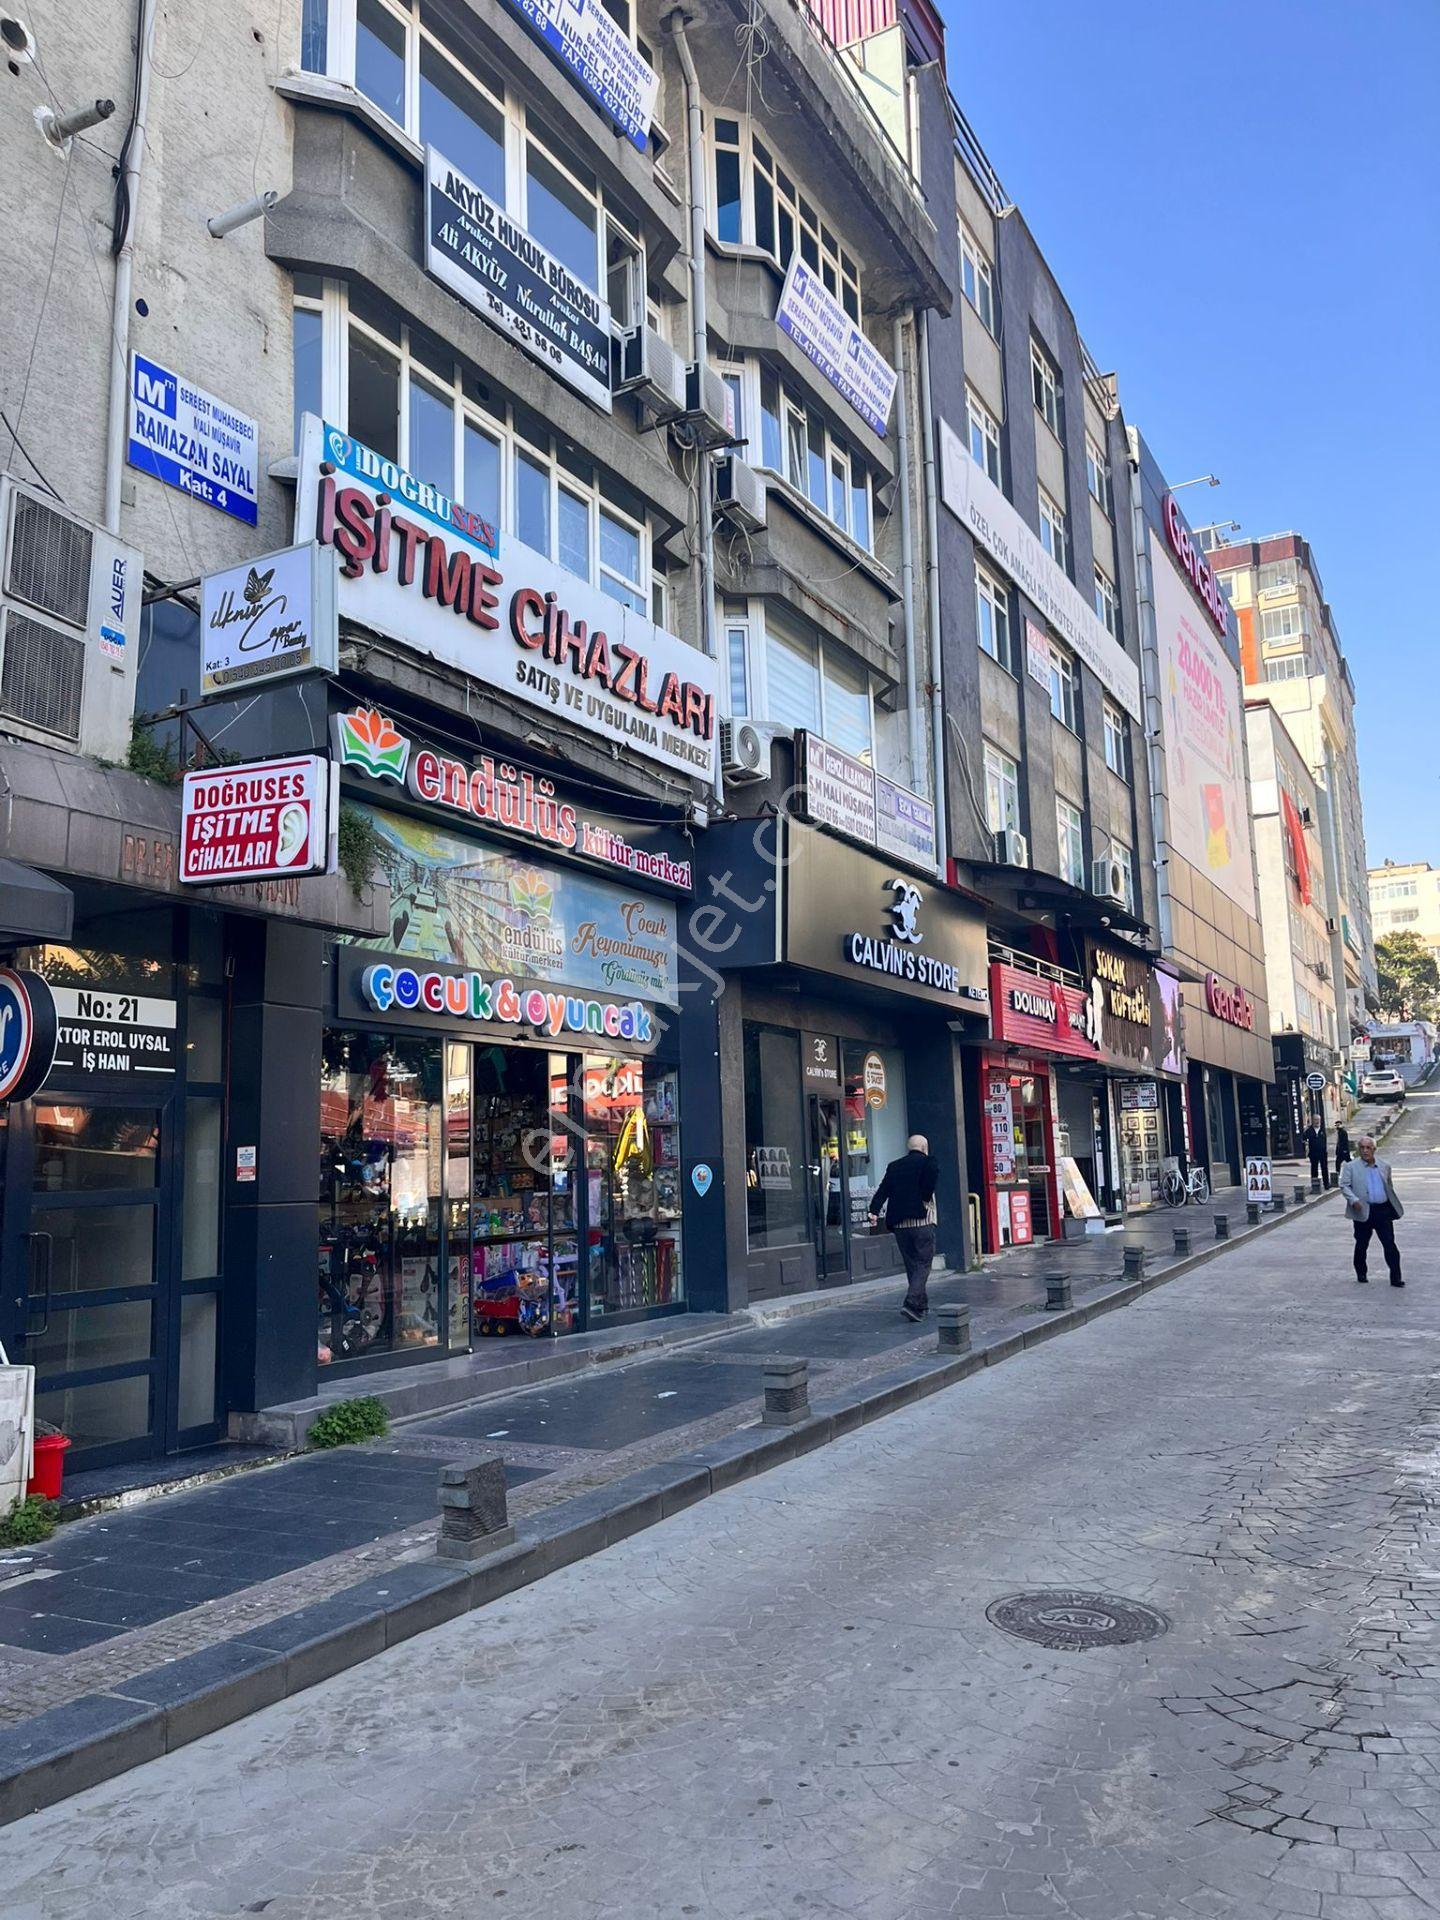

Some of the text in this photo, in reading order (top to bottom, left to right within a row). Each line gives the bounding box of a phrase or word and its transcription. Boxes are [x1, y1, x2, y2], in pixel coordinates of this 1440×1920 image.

[586, 0, 615, 36] SERBEST
[560, 18, 600, 73] NURSEL
[602, 69, 646, 127] CANKURT
[560, 42, 582, 73] FAX:
[582, 66, 603, 96] 0362
[603, 94, 618, 115] 432
[445, 171, 600, 326] AKYÜZ HUKUK BÜROSU
[456, 215, 493, 251] Avukat
[438, 222, 508, 291] Ali AKYÜZ
[550, 294, 580, 326] Avukat
[516, 283, 608, 376] Nurullah BAŞAR
[534, 332, 548, 352] 58
[550, 344, 562, 364] 08
[180, 387, 254, 441] SERBEST MUHASEBECİ
[136, 409, 254, 495] RAMAZAN SAYAL
[194, 416, 241, 454] MALİ MÜŞAVİR
[179, 469, 228, 507] Kat: 4
[970, 500, 992, 542] ÖZEL
[993, 531, 1009, 564] ÇOK
[111, 558, 124, 622] AUER
[316, 461, 714, 741] İŞİTME CİHAZLARI
[205, 656, 230, 672] Kat: 3
[1177, 630, 1213, 701] 20.000
[516, 660, 711, 771] SATIŞ VE UYGULAMA MERKEZİ
[194, 773, 305, 810] DOĞRUSES
[192, 807, 276, 845] İŞİTME
[414, 750, 693, 891] endülüs kültür merkezi
[188, 840, 272, 872] CİHAZLARI
[504, 924, 563, 956] endülüs
[620, 901, 668, 942] Çocuk
[502, 945, 564, 970] kültür merkezi
[570, 922, 669, 969] Reyonumuzu
[851, 932, 960, 993] CALVİN'S STORE
[1095, 948, 1127, 987] SOKAK
[77, 992, 139, 1022] No: 21
[522, 988, 654, 1042] oyuncak
[1013, 989, 1057, 1024] DOLUNAY
[82, 1047, 130, 1072] İŞ HANI
[93, 1030, 127, 1049] EROL
[129, 1033, 170, 1052] UYSAL
[992, 1084, 1001, 1094] 70
[994, 1123, 1008, 1133] 110
